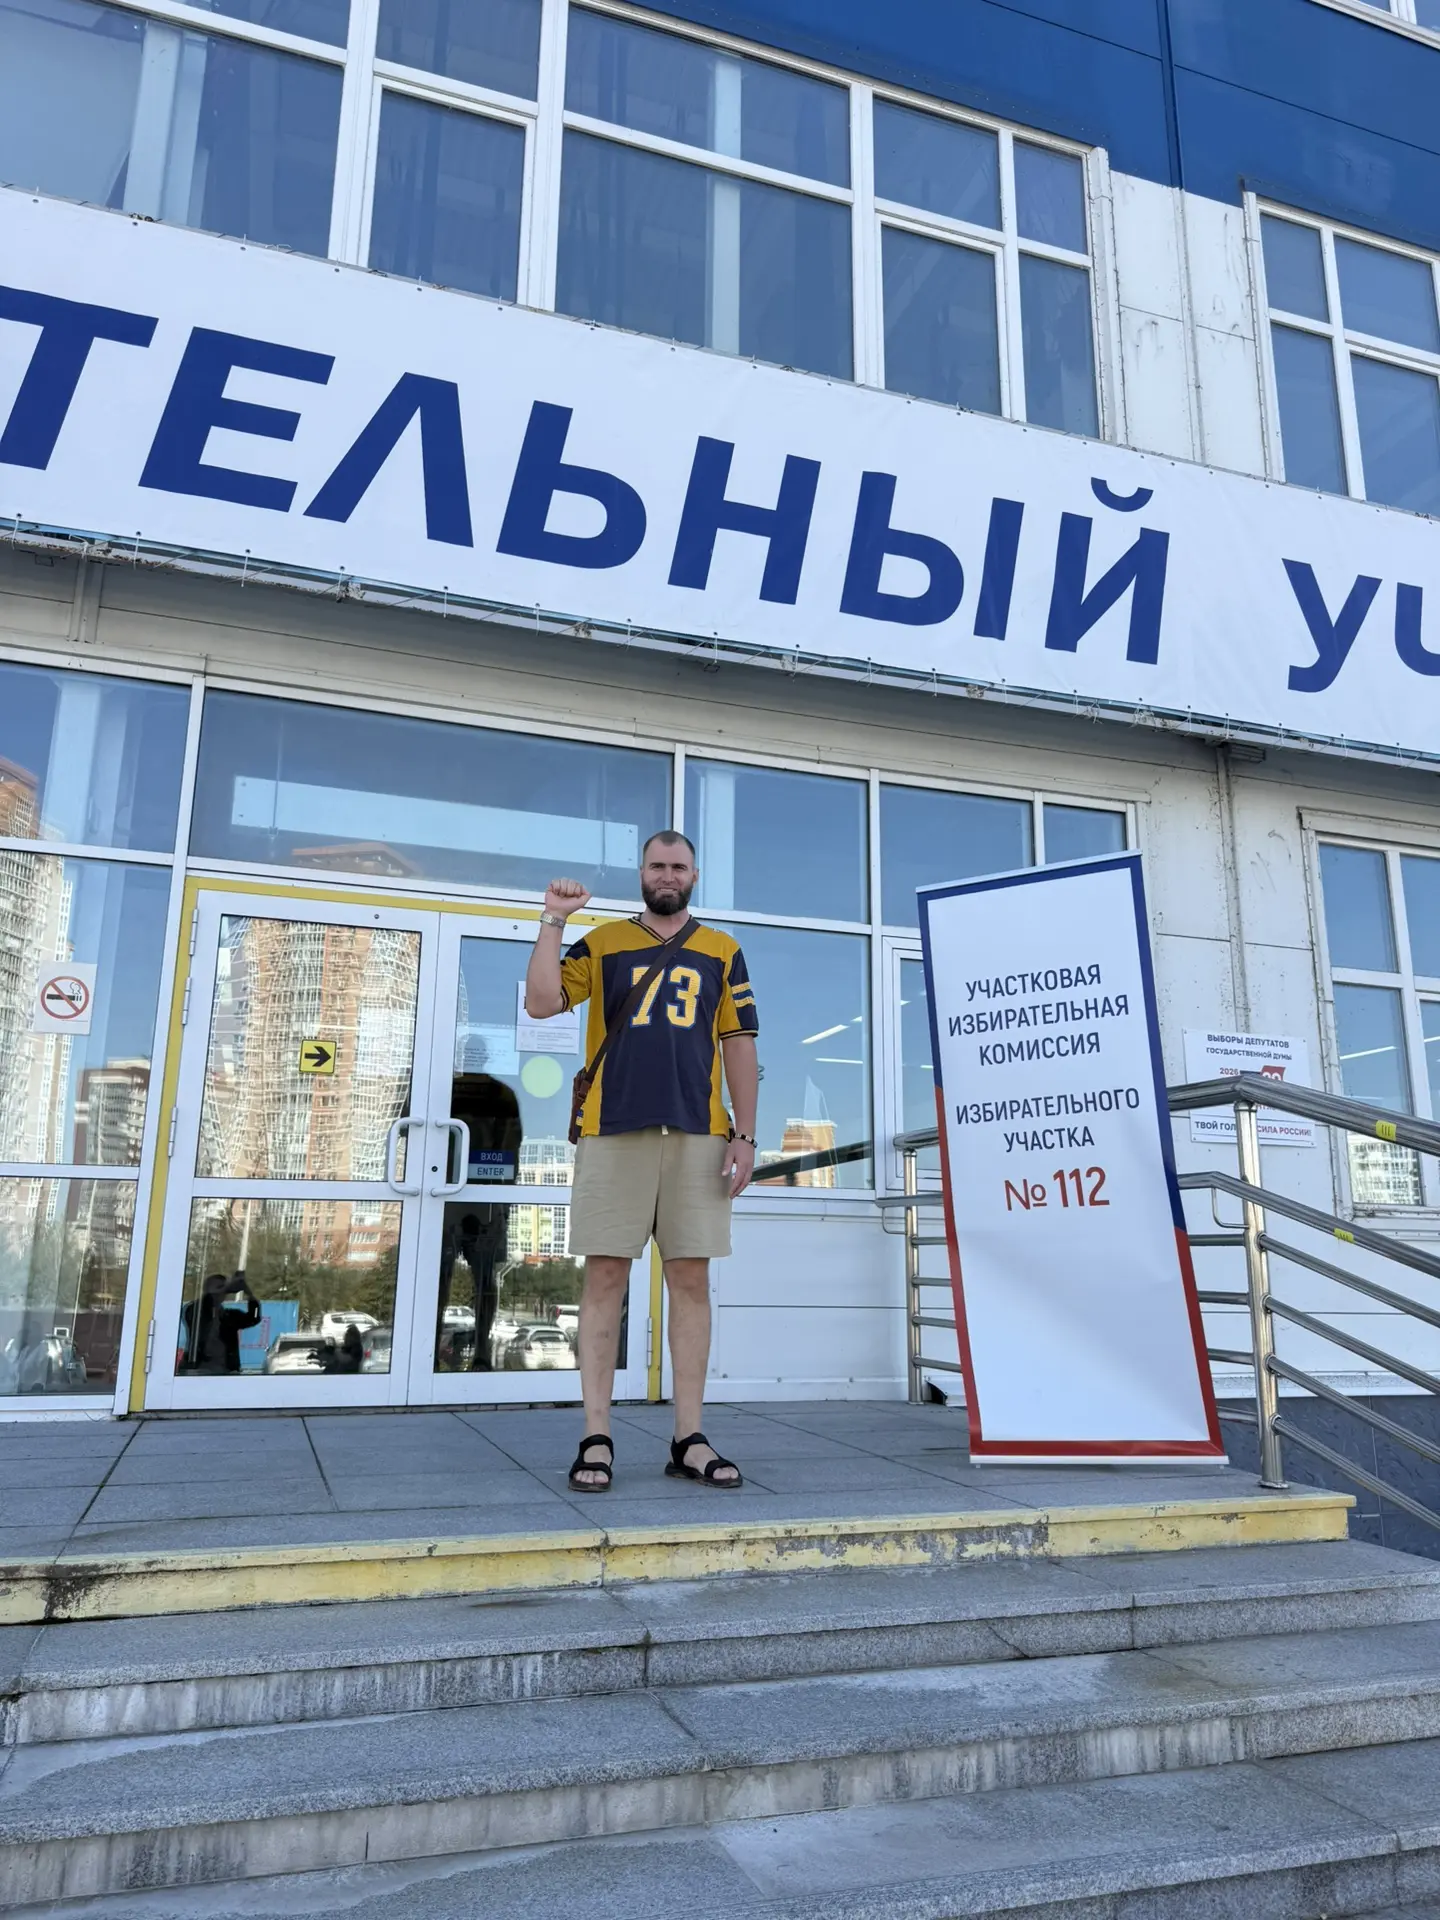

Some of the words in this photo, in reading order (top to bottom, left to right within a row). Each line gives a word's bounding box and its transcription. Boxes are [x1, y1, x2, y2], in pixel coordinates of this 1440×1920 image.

[965, 963, 1101, 1002] УЧАСТКОВАЯ
[630, 965, 701, 1029] 73
[948, 994, 1129, 1037] ИЗБИРАТЕЛЬНАЯ
[979, 1032, 1101, 1067] КОМИССИЯ
[1206, 1047, 1272, 1059] ГОСУДАРСТВЕННОЙ
[1273, 1052, 1292, 1060] ДУМЫ
[1207, 1034, 1243, 1044] ВЫБОРЫ
[1245, 1037, 1289, 1048] ДЕПУТАТОВ
[1219, 1067, 1239, 1076] 2026
[956, 1087, 1140, 1125] ИЗБИРАТЕЛЬНОГО
[1003, 1126, 1095, 1152] УЧАСТКА
[1195, 1121, 1218, 1130] ТВОЙ
[1220, 1123, 1236, 1131] ГОЛ
[1256, 1125, 1278, 1134] СИЛА
[480, 1152, 503, 1162] ВХОД
[477, 1167, 504, 1176] ENTER
[1004, 1178, 1047, 1211] №
[1053, 1166, 1110, 1208] 112
